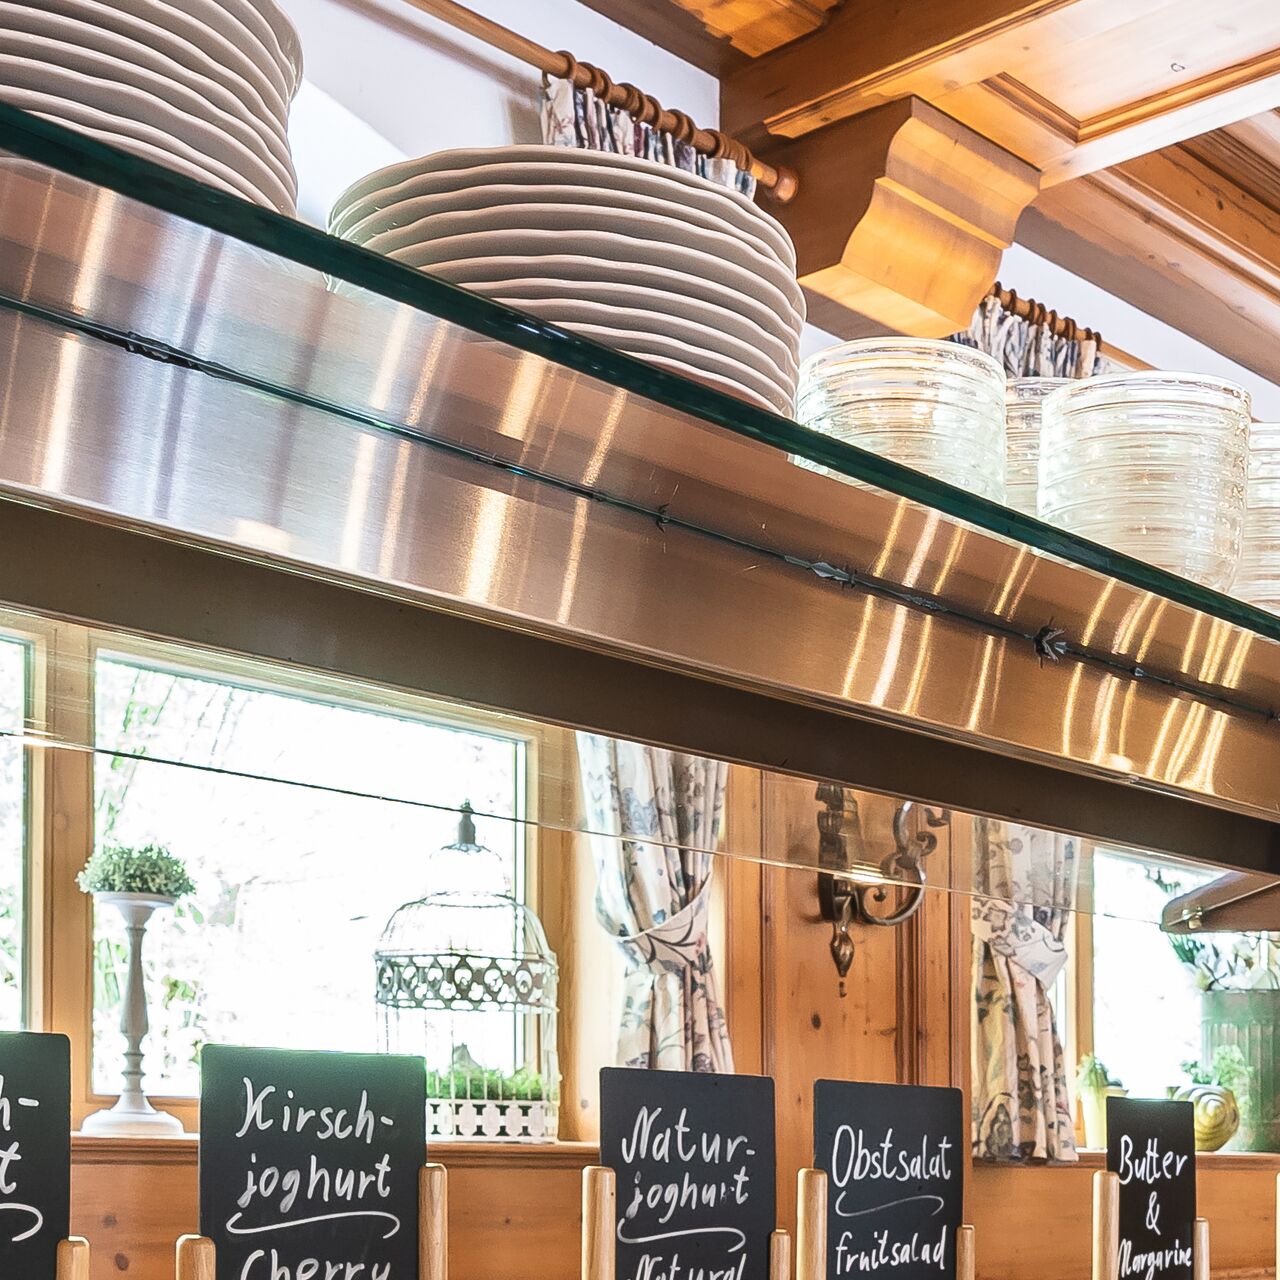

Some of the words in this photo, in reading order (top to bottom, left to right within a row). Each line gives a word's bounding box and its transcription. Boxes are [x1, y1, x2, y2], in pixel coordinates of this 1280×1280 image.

[236, 1077, 394, 1143] Kirsch-
[622, 1106, 755, 1163] Natur-
[237, 1153, 391, 1213] joghurt
[832, 1125, 952, 1187] Obstsalat
[1119, 1134, 1188, 1185] Butter
[1145, 1191, 1161, 1236] &
